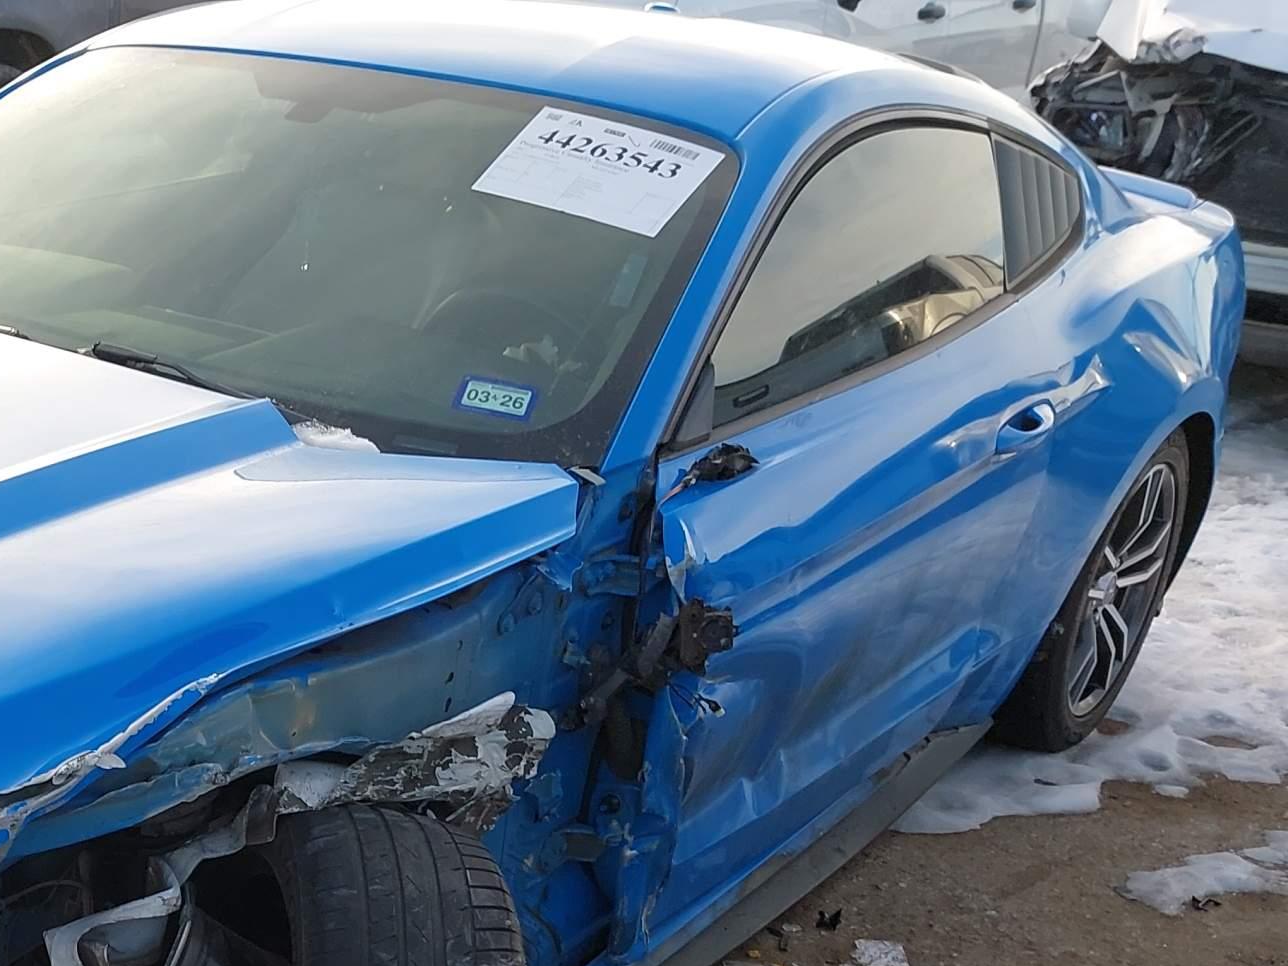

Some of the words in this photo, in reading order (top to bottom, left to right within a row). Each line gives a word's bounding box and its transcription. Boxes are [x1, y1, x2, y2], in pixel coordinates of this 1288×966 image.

[538, 130, 682, 180] 44263543
[467, 389, 491, 404] 03
[499, 395, 525, 410] 26
